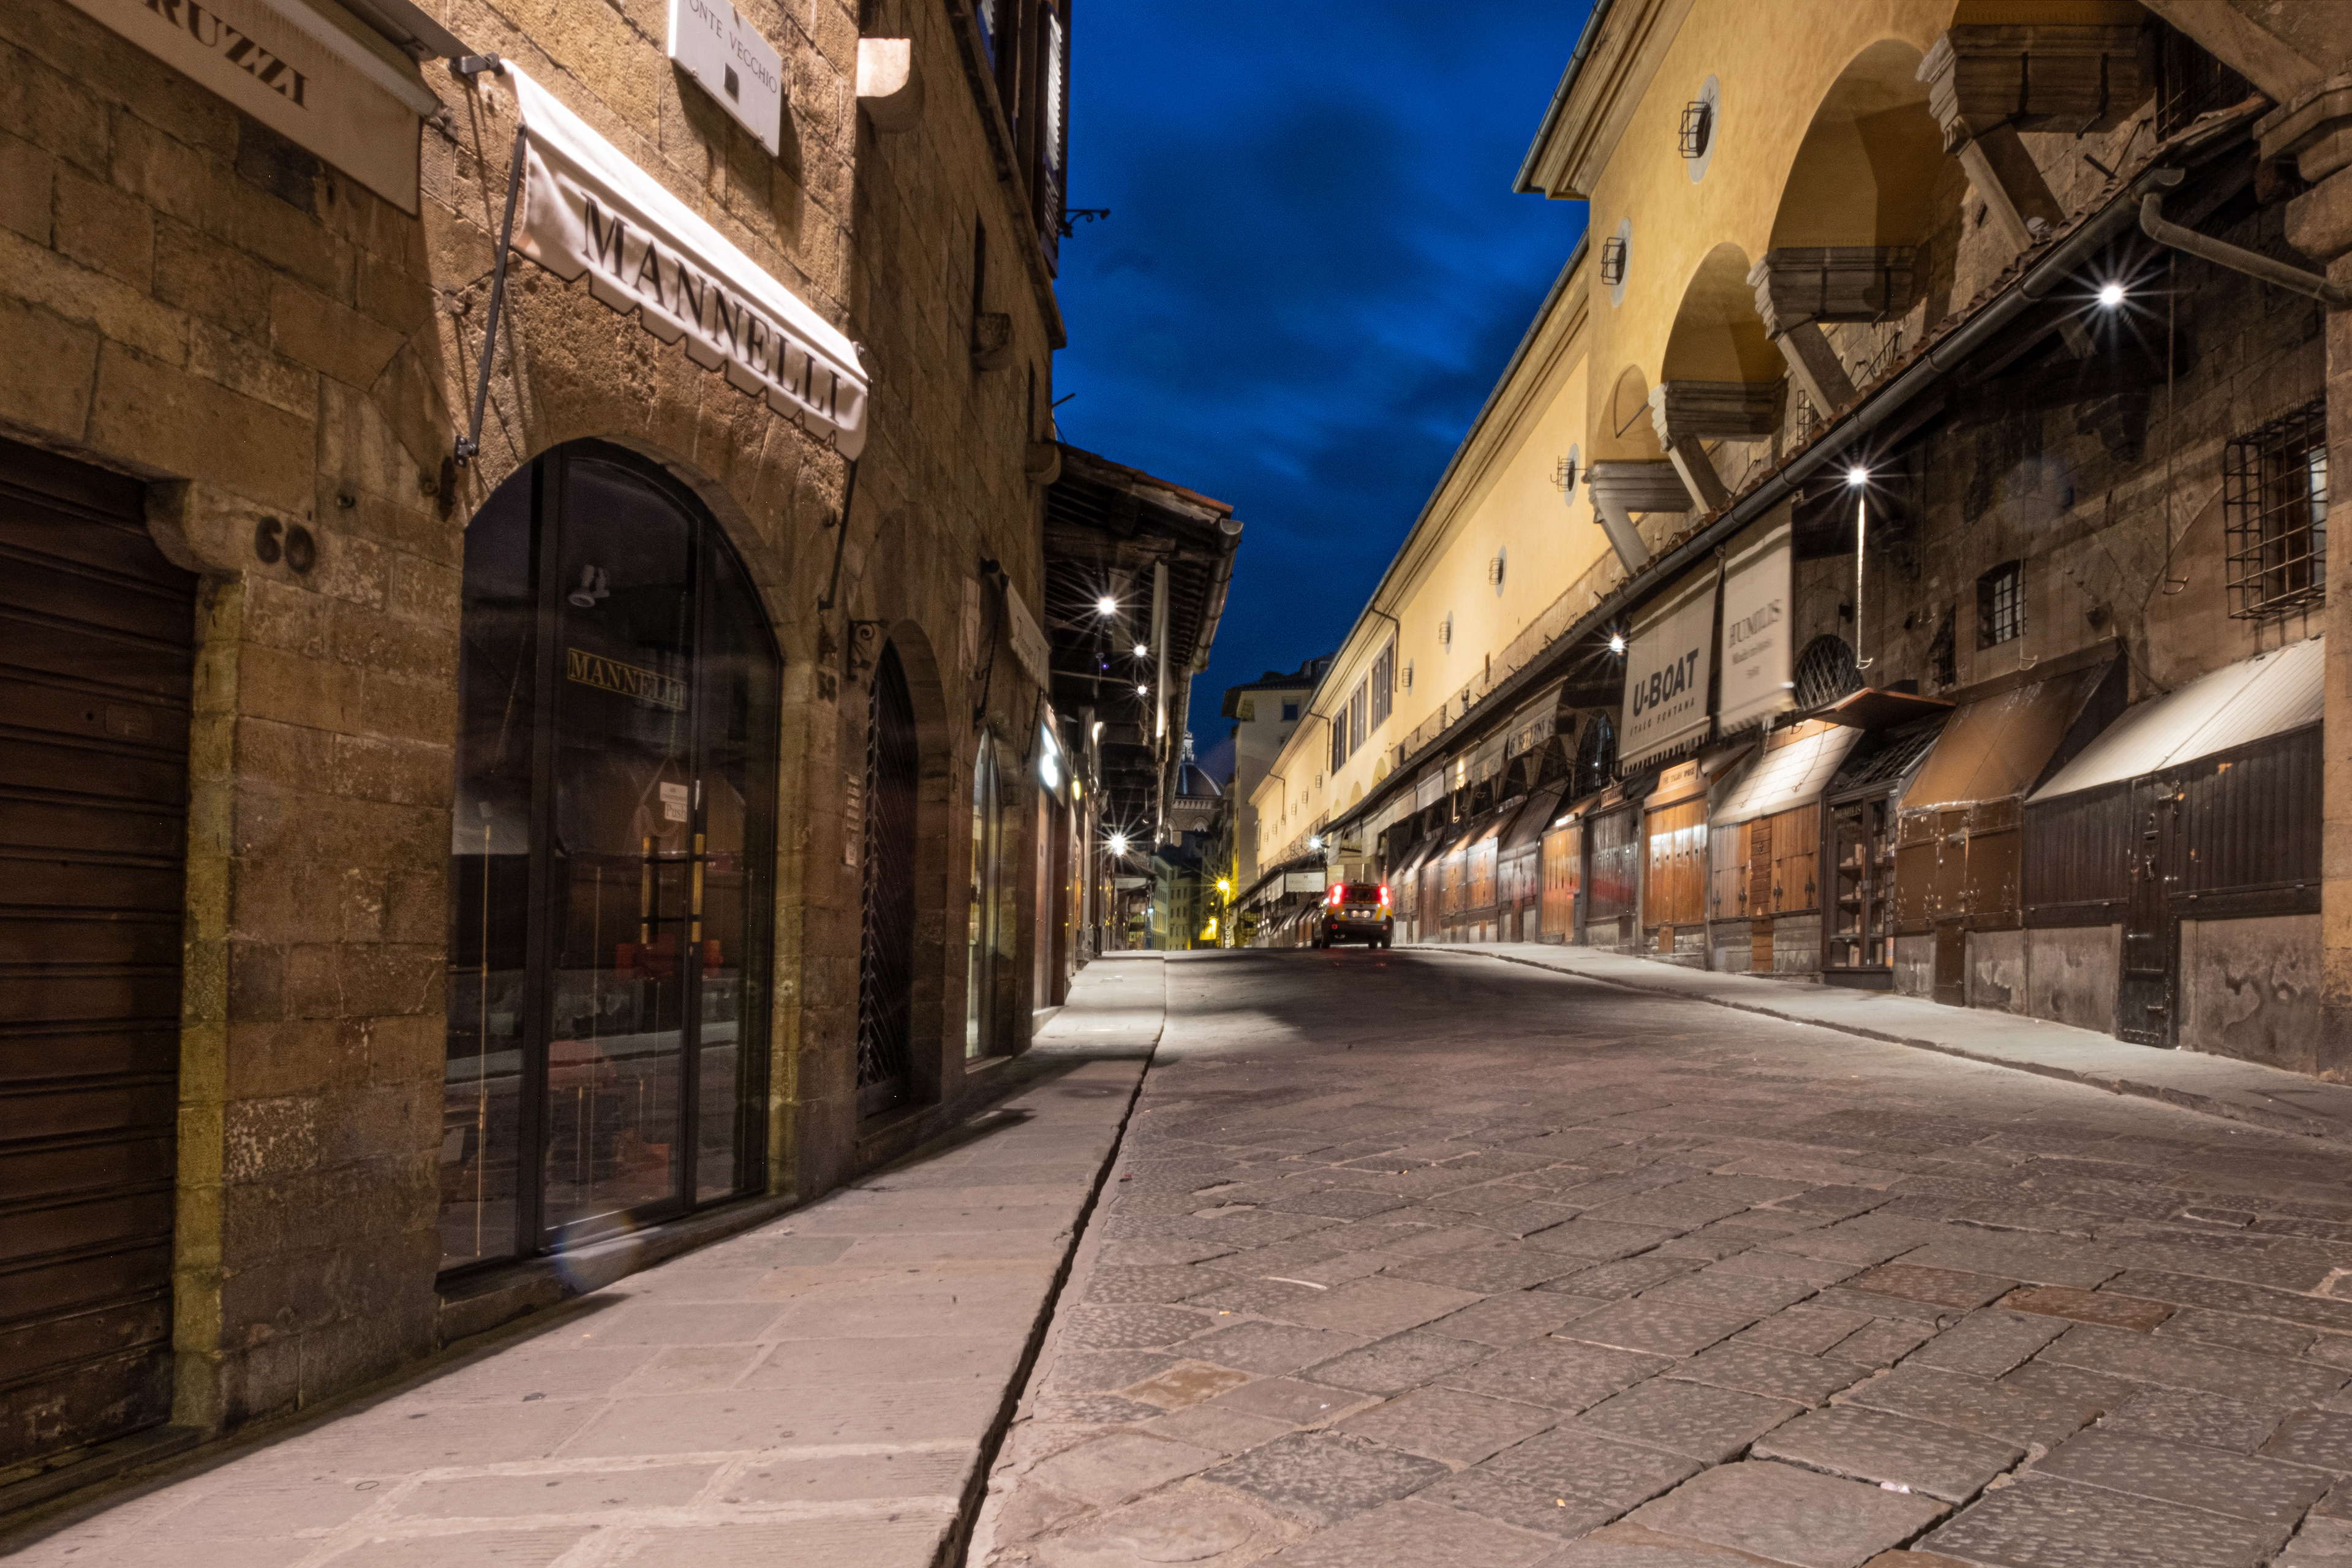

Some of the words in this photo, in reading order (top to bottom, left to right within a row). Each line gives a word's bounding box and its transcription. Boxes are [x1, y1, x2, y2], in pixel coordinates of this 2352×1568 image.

[683, 0, 723, 39] ONTE
[729, 31, 777, 94] VECCHIO
[581, 190, 842, 424] MANNELLI
[1630, 718, 1651, 737] ITALO
[1657, 697, 1694, 724] FONTANA
[1633, 647, 1699, 717] U-BOAT
[666, 803, 687, 819] Push
